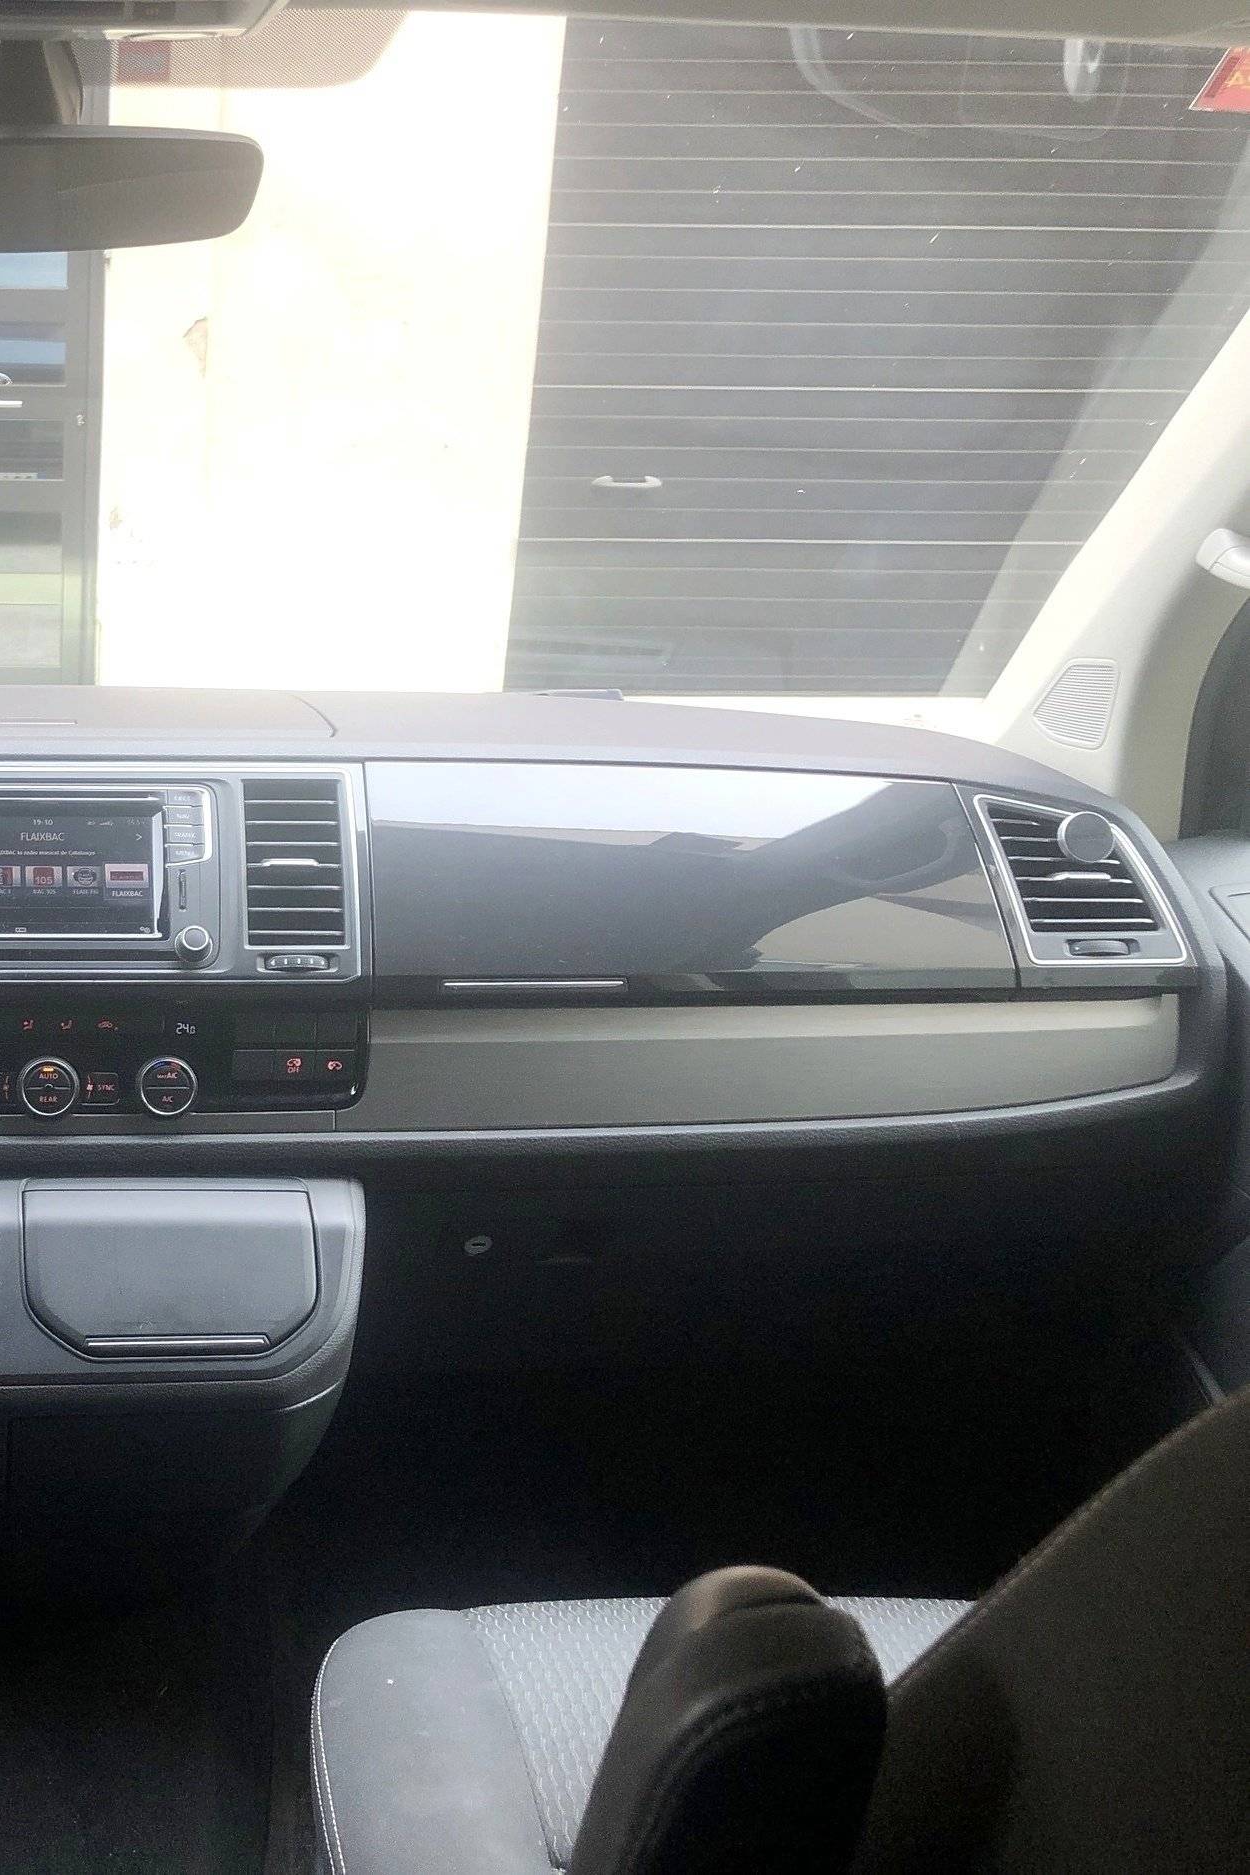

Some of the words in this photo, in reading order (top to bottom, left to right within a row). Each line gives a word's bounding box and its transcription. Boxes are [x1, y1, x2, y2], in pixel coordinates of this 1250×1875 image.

[20, 832, 65, 841] FLAIXBAC
[36, 876, 54, 885] 105
[38, 1072, 59, 1080] AUTO
[39, 1095, 58, 1103] REAR
